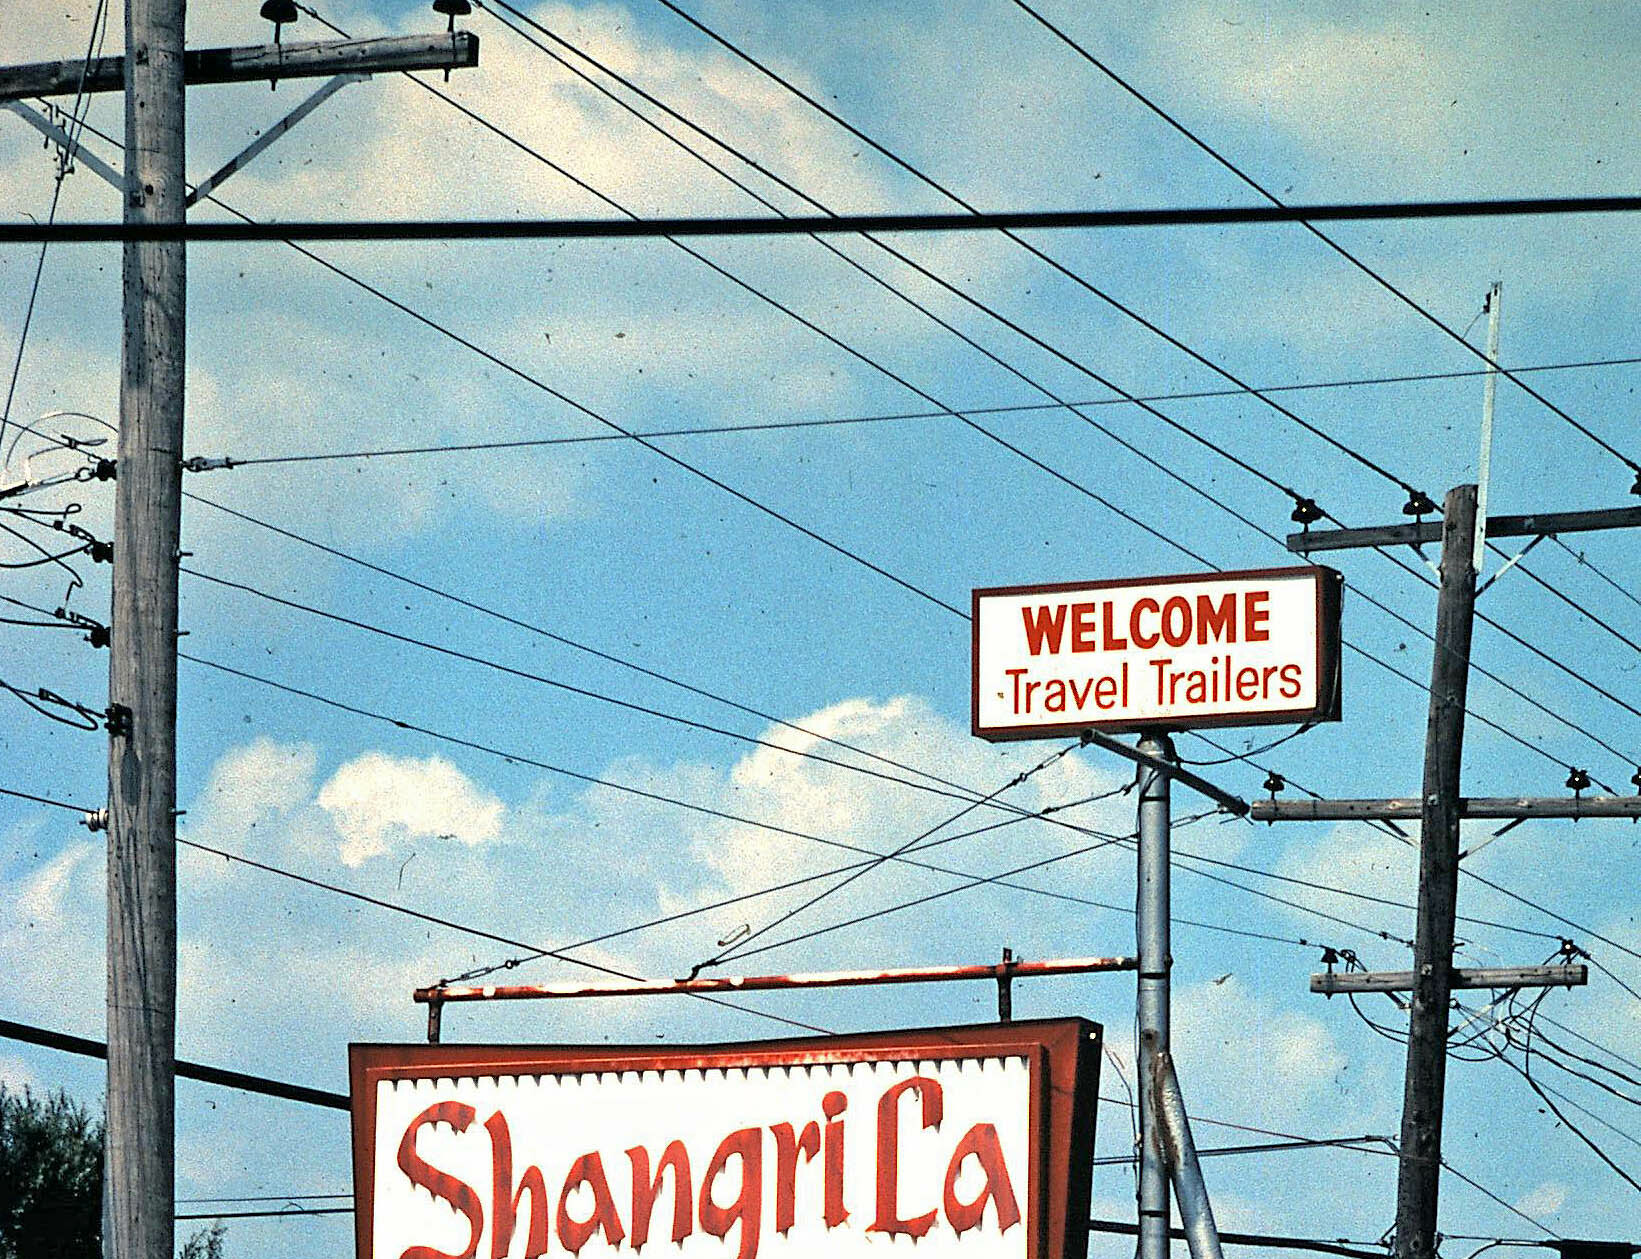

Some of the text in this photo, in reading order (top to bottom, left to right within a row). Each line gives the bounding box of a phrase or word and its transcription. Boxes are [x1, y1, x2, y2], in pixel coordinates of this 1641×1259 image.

[1021, 590, 1270, 656] WELCOME
[1005, 655, 1302, 715] Travel Trailers
[864, 1075, 1022, 1241] La
